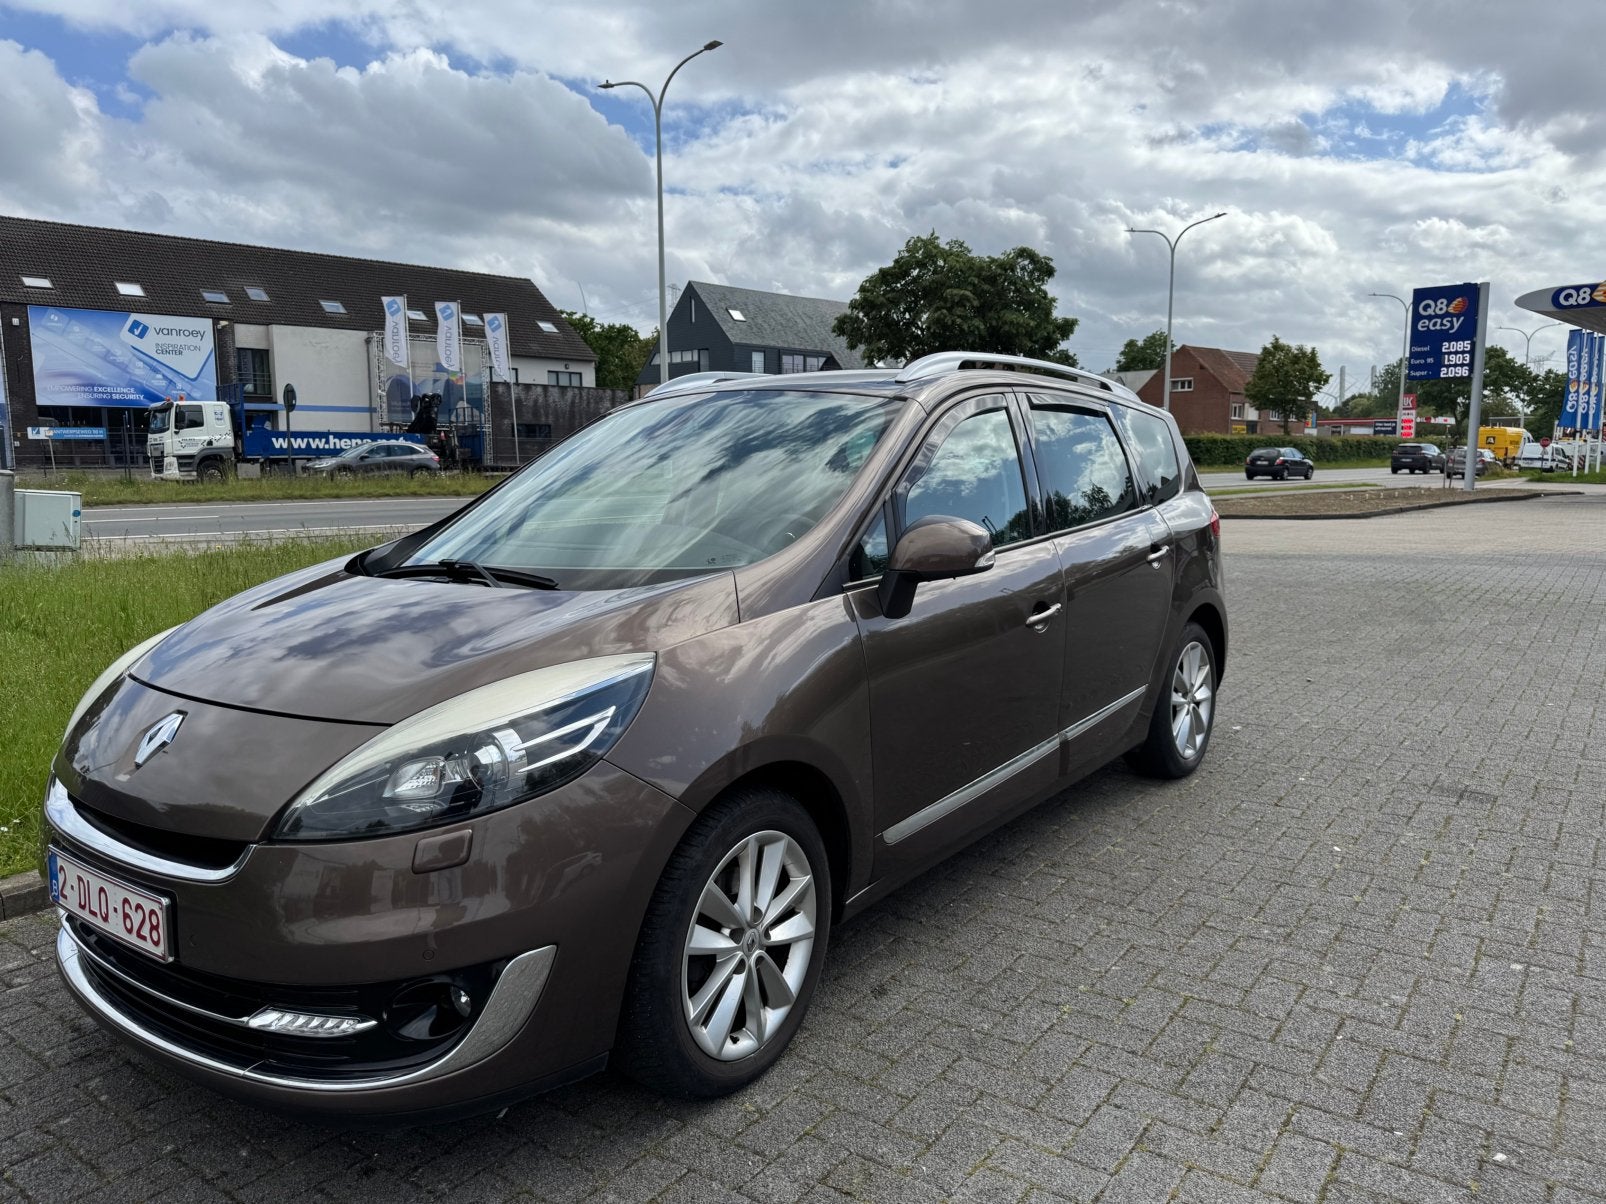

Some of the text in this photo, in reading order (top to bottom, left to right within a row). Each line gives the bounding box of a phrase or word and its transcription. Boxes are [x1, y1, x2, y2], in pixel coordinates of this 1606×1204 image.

[1558, 287, 1591, 306] Q8
[1419, 298, 1448, 316] Q8
[1417, 316, 1465, 333] easy
[153, 327, 206, 341] vanroey
[155, 343, 201, 351] INSPIRATION
[155, 348, 183, 356] CENTER
[58, 864, 161, 948] 2-DLQ-628
